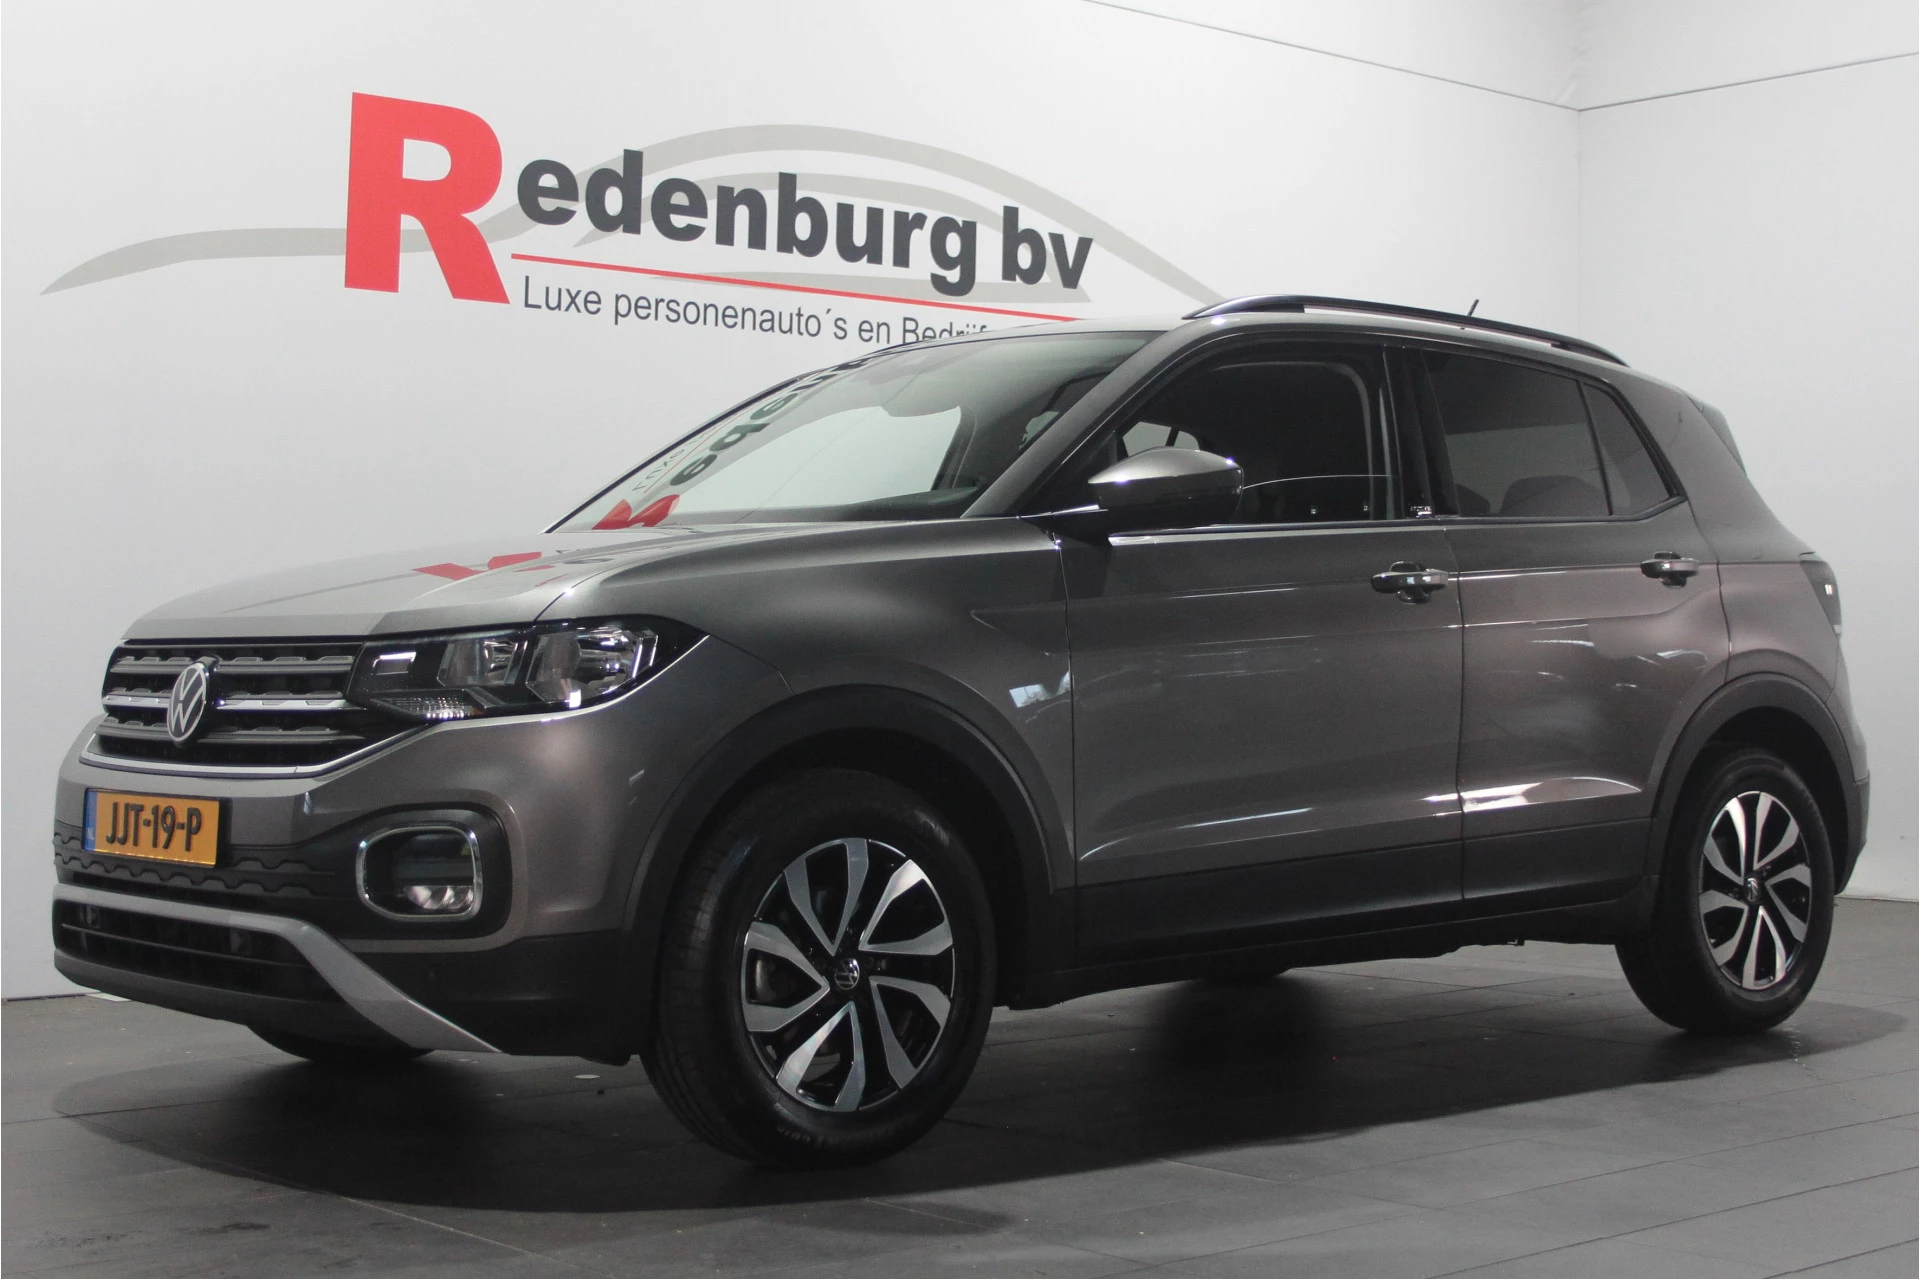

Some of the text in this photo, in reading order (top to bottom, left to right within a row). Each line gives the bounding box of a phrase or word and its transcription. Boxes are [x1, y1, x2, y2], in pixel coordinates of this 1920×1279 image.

[344, 92, 1093, 304] Redenburg bv
[524, 275, 602, 315] Luxe
[857, 319, 890, 345] en
[105, 802, 202, 851] JJT-19-P
